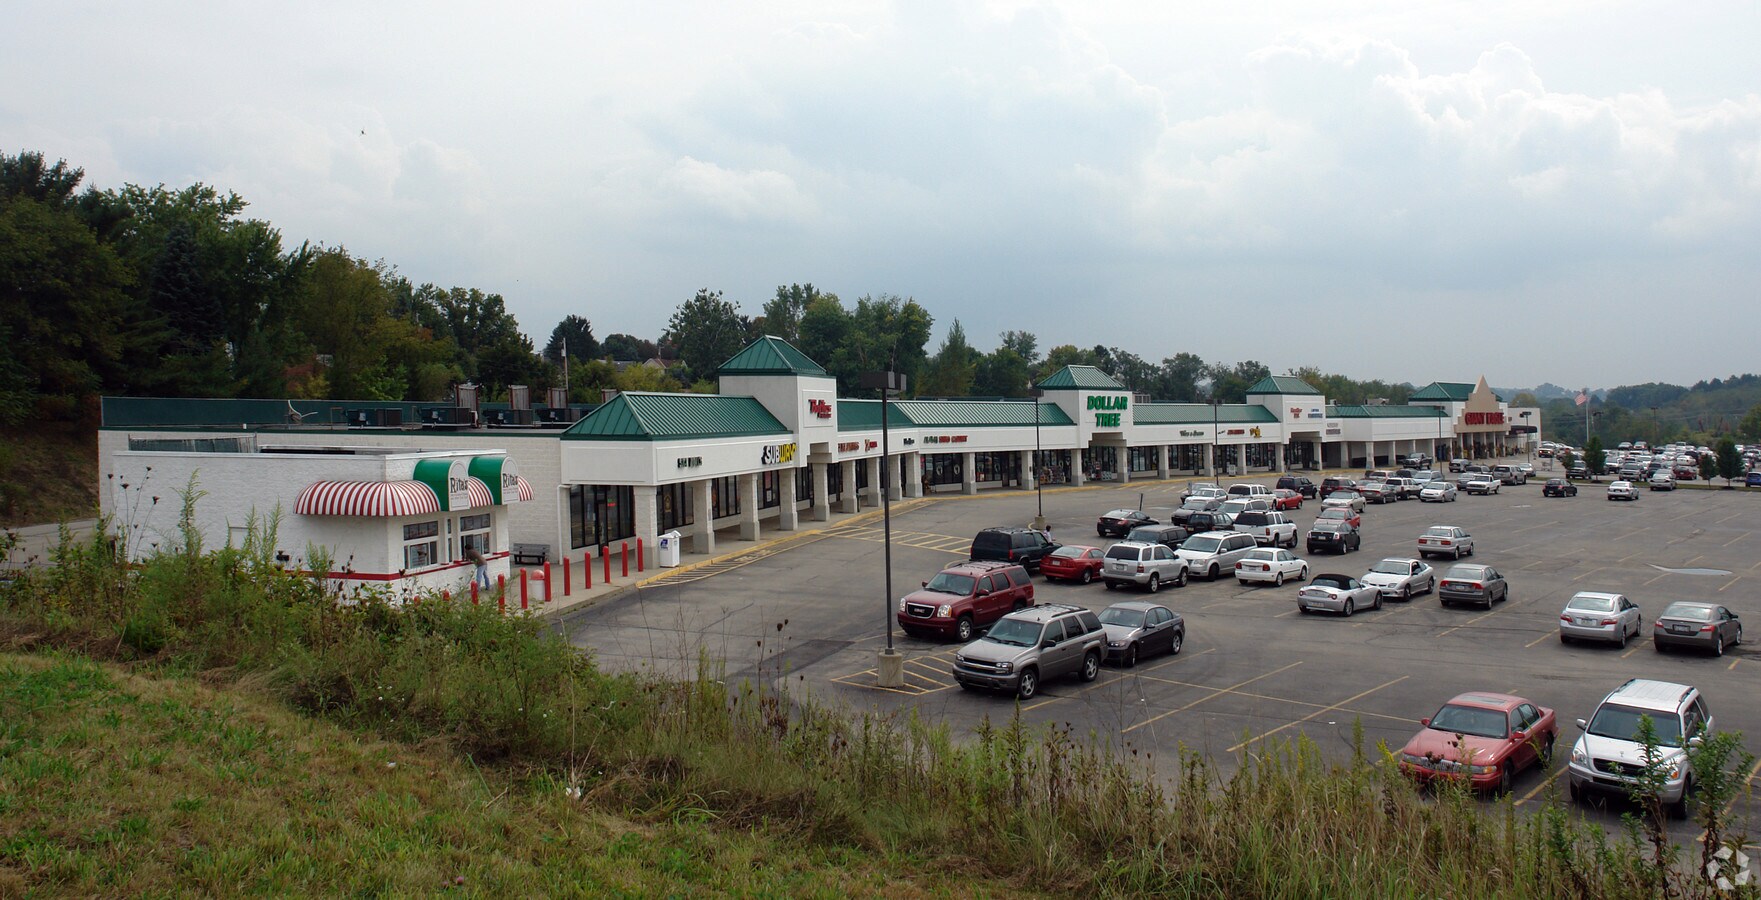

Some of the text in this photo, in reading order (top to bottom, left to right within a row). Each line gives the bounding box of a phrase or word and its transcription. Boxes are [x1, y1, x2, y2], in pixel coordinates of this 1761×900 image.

[1087, 395, 1128, 410] DOLLAR
[1095, 413, 1121, 427] TREE
[761, 442, 797, 464] SUBWAY
[449, 477, 469, 493] Rita's
[503, 473, 519, 488] Rita's
